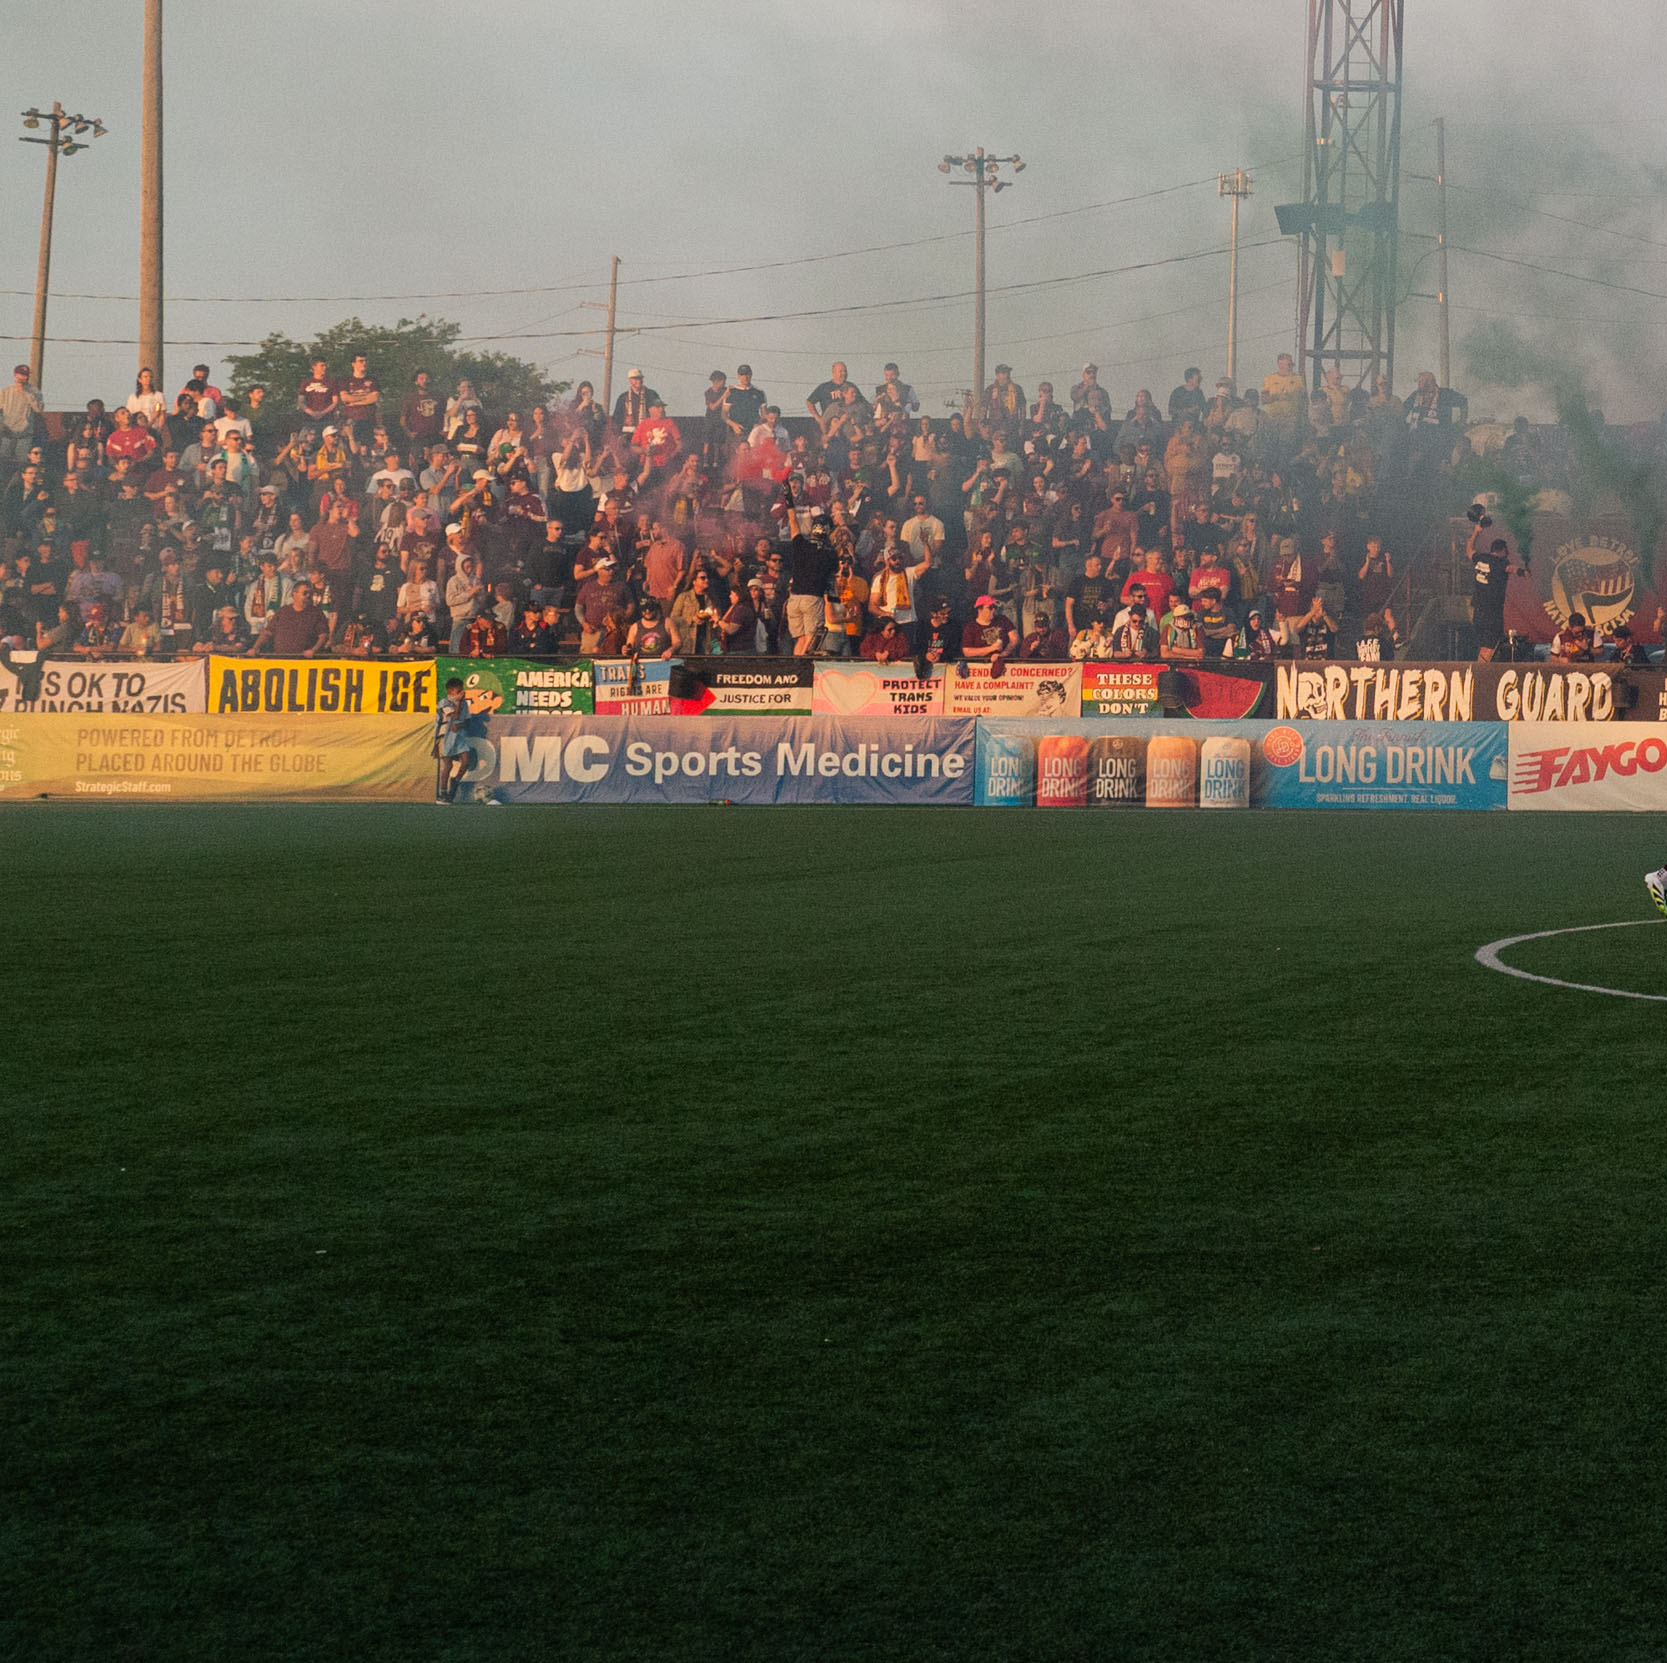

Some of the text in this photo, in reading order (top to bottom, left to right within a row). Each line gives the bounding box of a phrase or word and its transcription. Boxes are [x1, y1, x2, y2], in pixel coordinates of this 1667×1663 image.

[1589, 536, 1640, 565] DETROI
[1596, 608, 1636, 637] SCISM
[716, 674, 798, 684] FREEDOM AND
[1010, 667, 1074, 677] CONCERNED?
[1096, 673, 1153, 685] THESE
[16, 671, 145, 698] I'S OK TO
[218, 667, 431, 713] ABOLISH ICE
[610, 684, 662, 697] RIGTS ARE
[882, 679, 942, 690] PROTECT
[955, 681, 1034, 690] HAVE A COMPLAINT?
[1092, 688, 1156, 700] COLORS
[112, 693, 187, 713] NAZIS
[516, 691, 573, 707] NEEDS
[720, 693, 791, 704] JUSTICE FOR
[890, 692, 933, 702] TRANS
[1496, 669, 1615, 721] GUARD
[621, 699, 671, 715] HUMAN
[893, 704, 927, 714] KIDS
[1099, 702, 1149, 715] DON'T
[77, 728, 298, 748] POWERED FROM DETROIT
[76, 753, 326, 772] PLACED AROUND THE GLOBE
[452, 735, 610, 783] DMC
[625, 742, 965, 784] Sports Medicine
[991, 756, 1022, 777] LON
[1044, 757, 1083, 778] LONG
[1099, 758, 1137, 778] LONG
[1153, 758, 1191, 778] LONG
[1207, 759, 1245, 778] LONG
[1299, 745, 1377, 783] LONG
[1386, 746, 1476, 785] DRINK
[75, 780, 171, 795] StrategicStaff.com
[988, 777, 1025, 797] DRIN
[1096, 778, 1138, 798] DRINK
[1205, 780, 1246, 799] DRINK
[1316, 793, 1355, 803] SPARKLING
[1411, 795, 1428, 804] REAL
